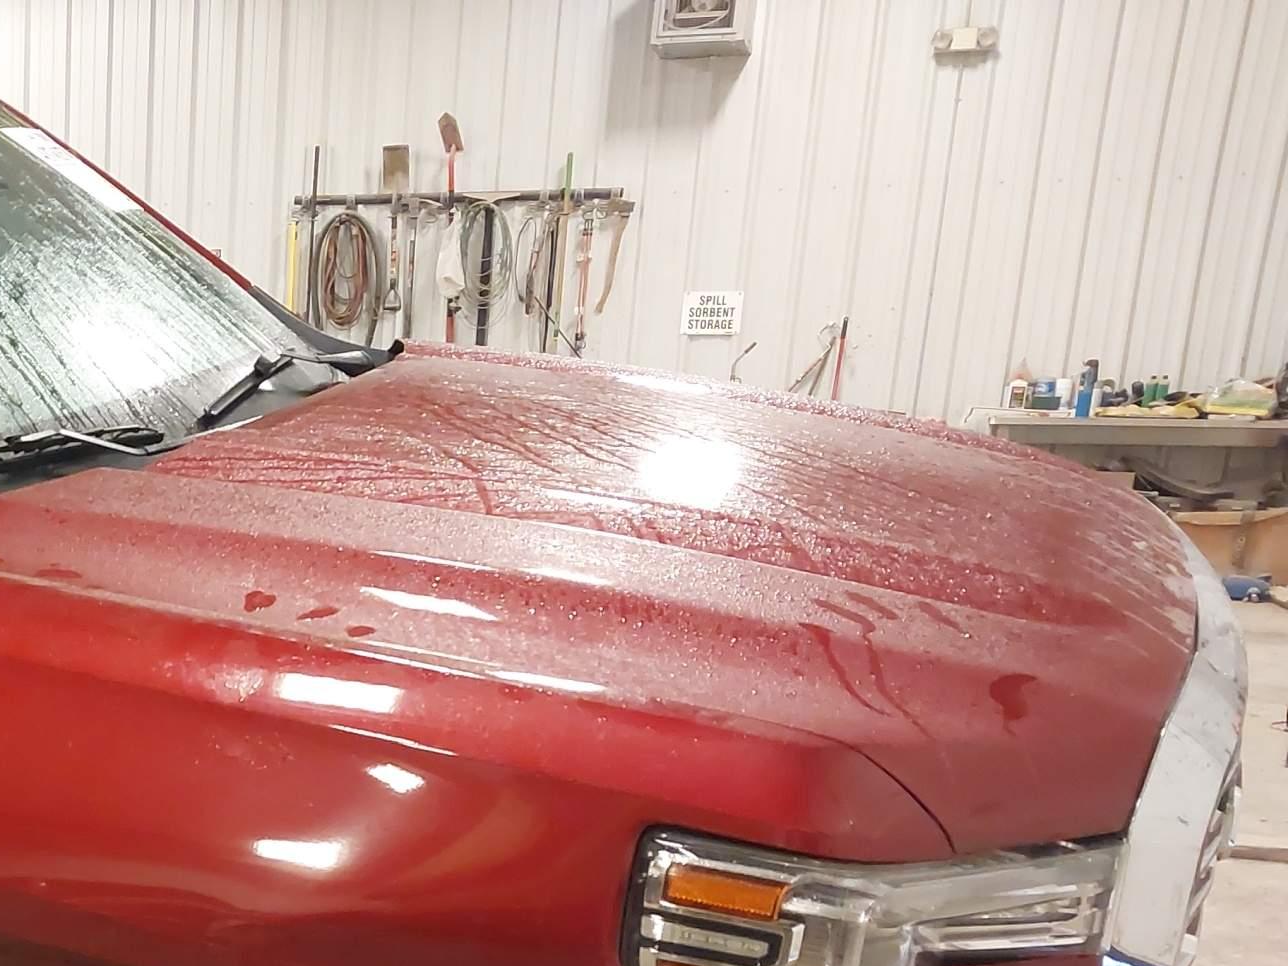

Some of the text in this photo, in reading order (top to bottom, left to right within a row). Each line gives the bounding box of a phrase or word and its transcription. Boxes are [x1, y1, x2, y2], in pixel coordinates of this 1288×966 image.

[699, 295, 728, 306] SPILL
[688, 307, 736, 318] SORBENT
[687, 319, 734, 330] STORAGE
